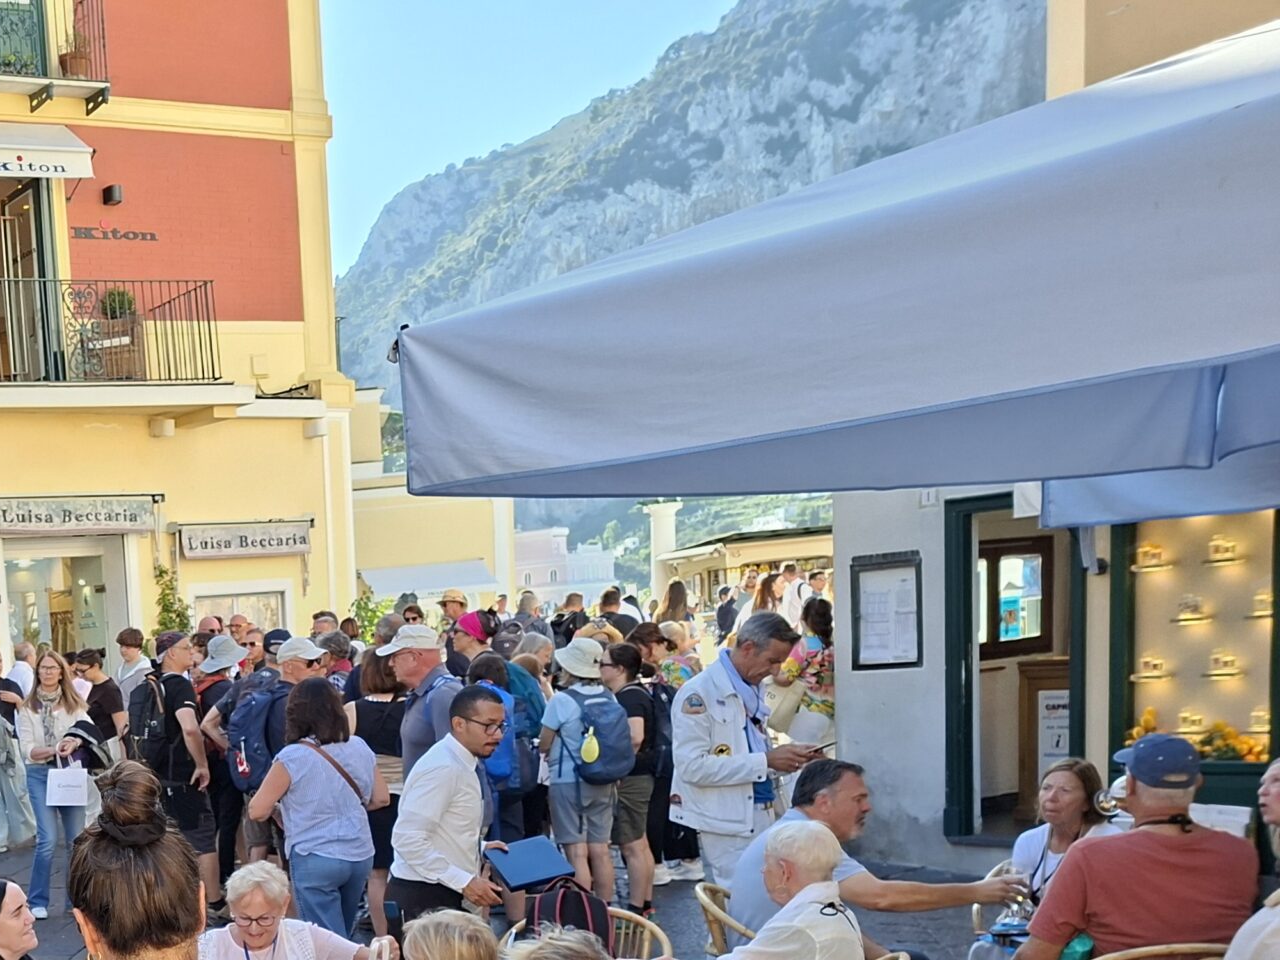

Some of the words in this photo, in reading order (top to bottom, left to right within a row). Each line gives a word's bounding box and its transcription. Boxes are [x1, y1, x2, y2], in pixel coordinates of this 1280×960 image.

[70, 218, 160, 241] Kiton
[0, 508, 54, 524] Luisa
[61, 508, 138, 524] Beccaria
[187, 536, 233, 551] Luisa
[239, 532, 308, 549] Beccaria
